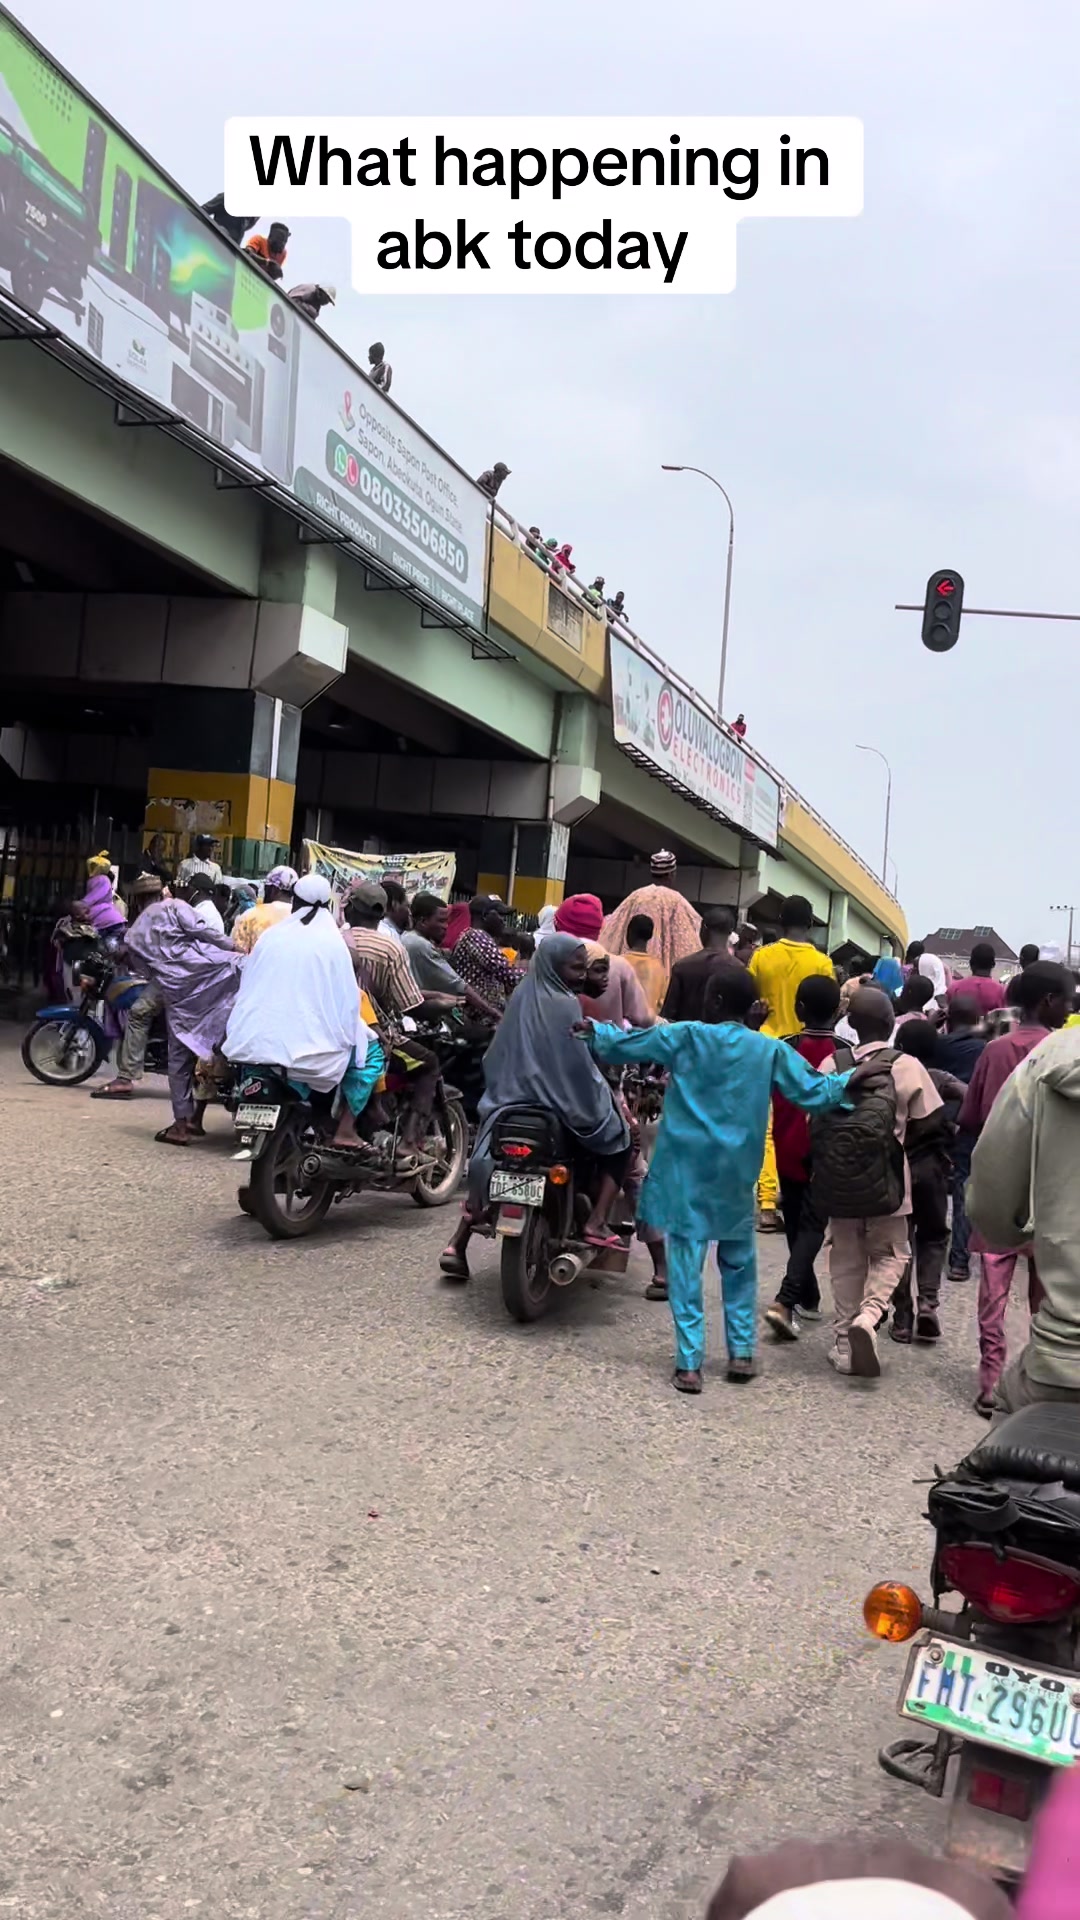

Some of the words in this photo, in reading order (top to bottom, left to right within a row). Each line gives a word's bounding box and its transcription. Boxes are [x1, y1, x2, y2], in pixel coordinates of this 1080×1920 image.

[359, 403, 396, 448] Opposite
[397, 438, 421, 472] Sapon
[421, 461, 437, 489] Post
[316, 491, 340, 520] RIGHT
[340, 510, 377, 549] PRODUCTS
[360, 467, 465, 574] 08033506850
[425, 490, 444, 518] Ogun
[392, 551, 412, 576] RIGHT
[412, 566, 430, 589] PRICE
[673, 736, 741, 805] ELECTRONICS
[675, 699, 743, 785] OLUWALOGBON
[985, 1661, 1066, 1693] OYO
